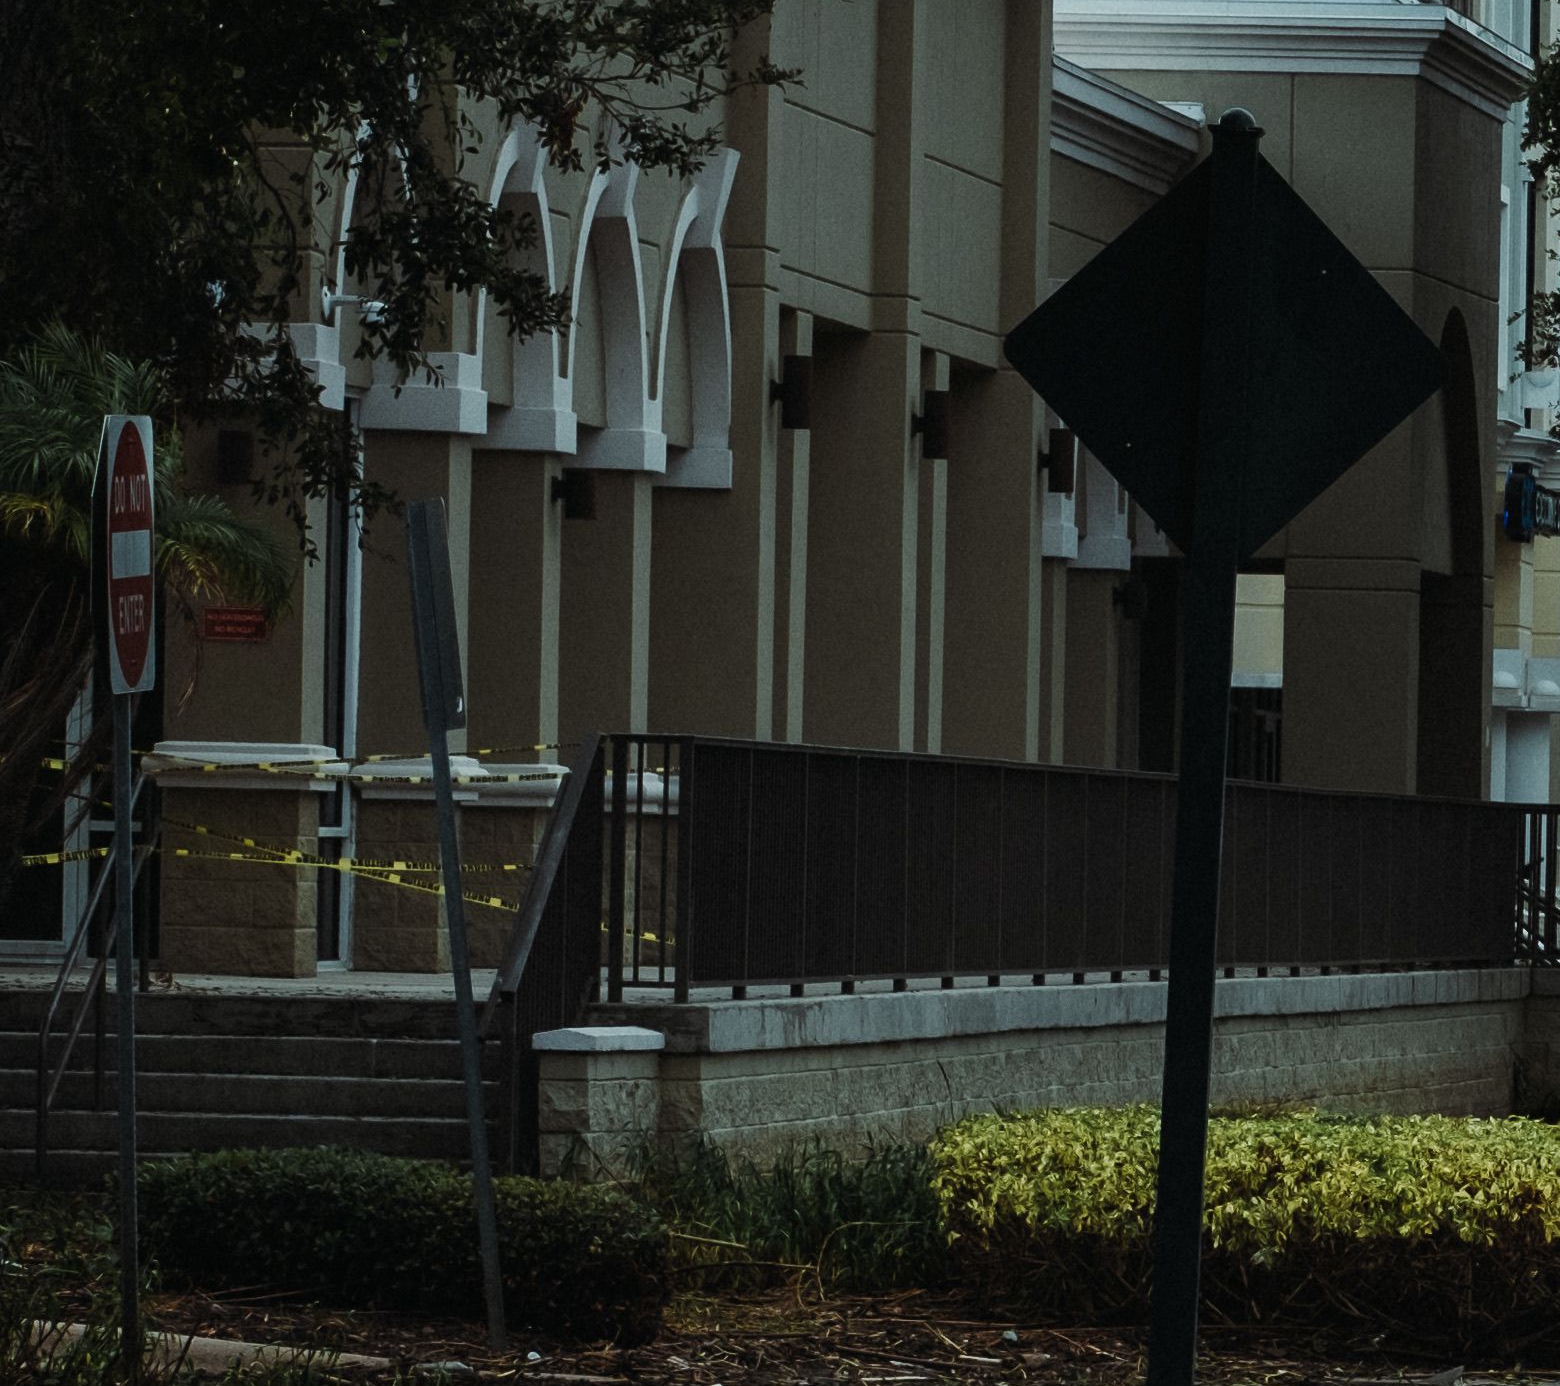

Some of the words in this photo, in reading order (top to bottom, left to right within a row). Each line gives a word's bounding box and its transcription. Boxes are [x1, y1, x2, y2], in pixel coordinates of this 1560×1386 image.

[114, 475, 126, 514] DO
[129, 474, 147, 513] NOT
[118, 594, 145, 635] ENTER
